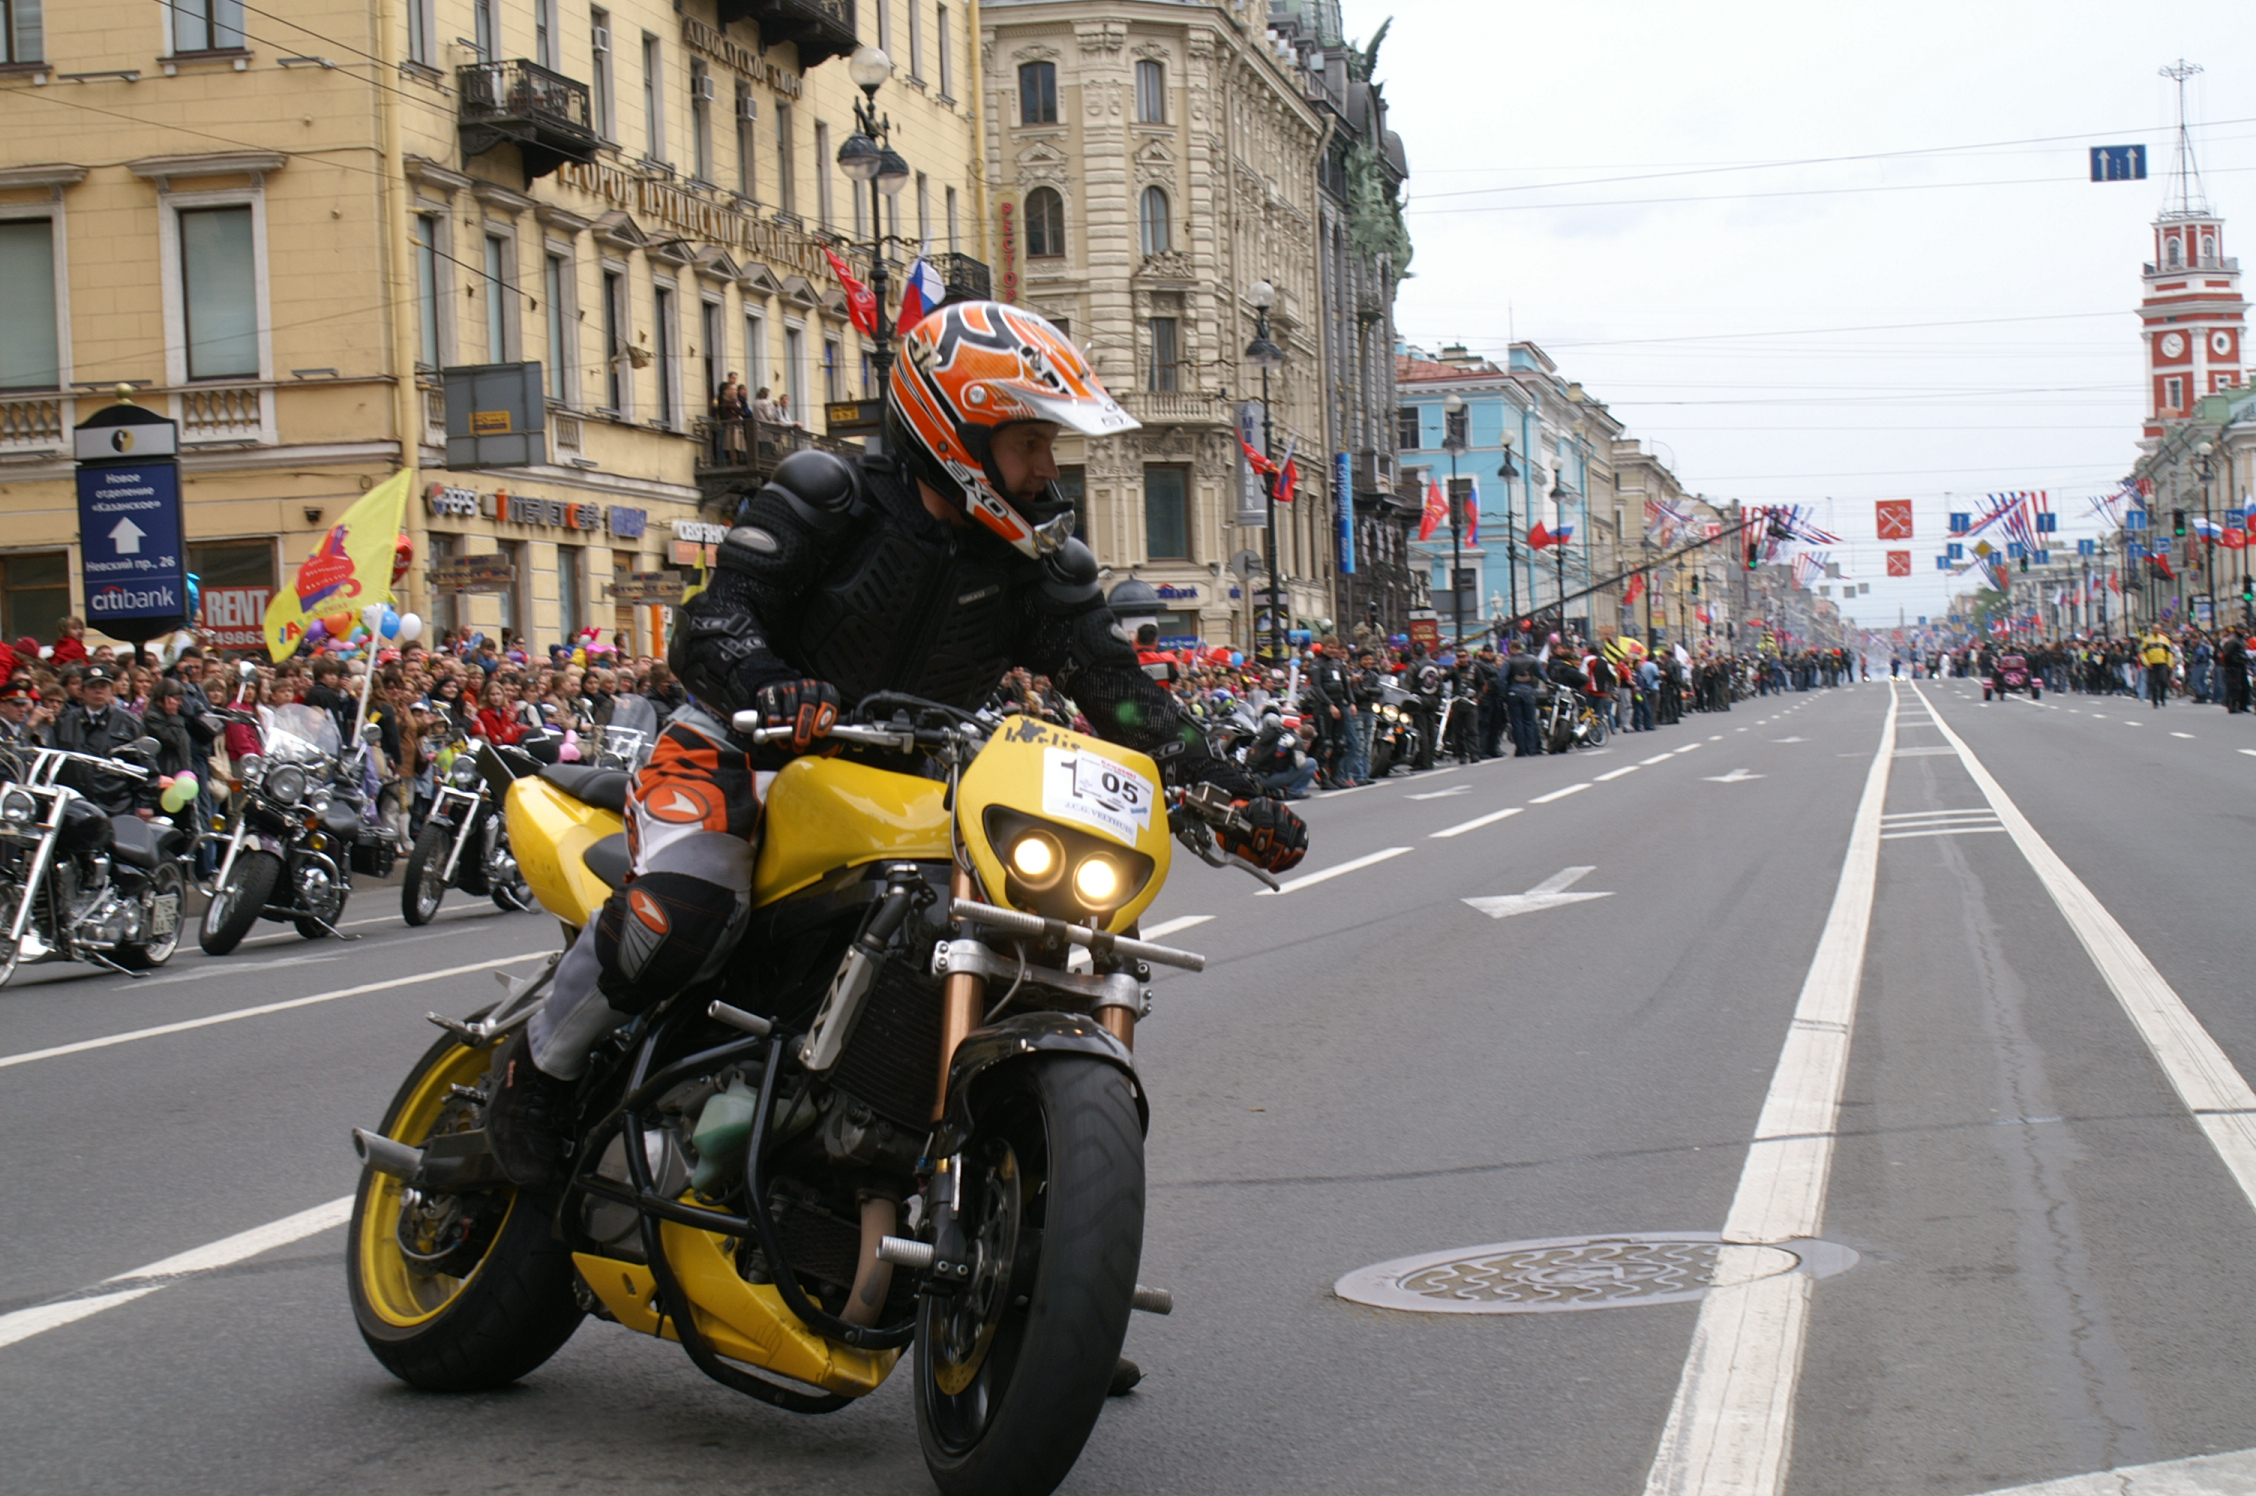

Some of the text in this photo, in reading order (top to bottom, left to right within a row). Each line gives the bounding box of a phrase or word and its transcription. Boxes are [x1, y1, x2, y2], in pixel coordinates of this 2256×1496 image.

[683, 18, 803, 100] АДВОКАТСКОЕ БЮРО
[558, 160, 635, 205] ЕГОРОВ
[640, 178, 740, 246] ПУГИНСКИЙ
[95, 486, 155, 499] отделение
[105, 473, 141, 485] Новое
[85, 558, 133, 573] Невский
[158, 556, 176, 568] 26
[91, 586, 175, 611] citibank
[205, 589, 269, 627] RENT
[1101, 771, 1139, 805] 05
